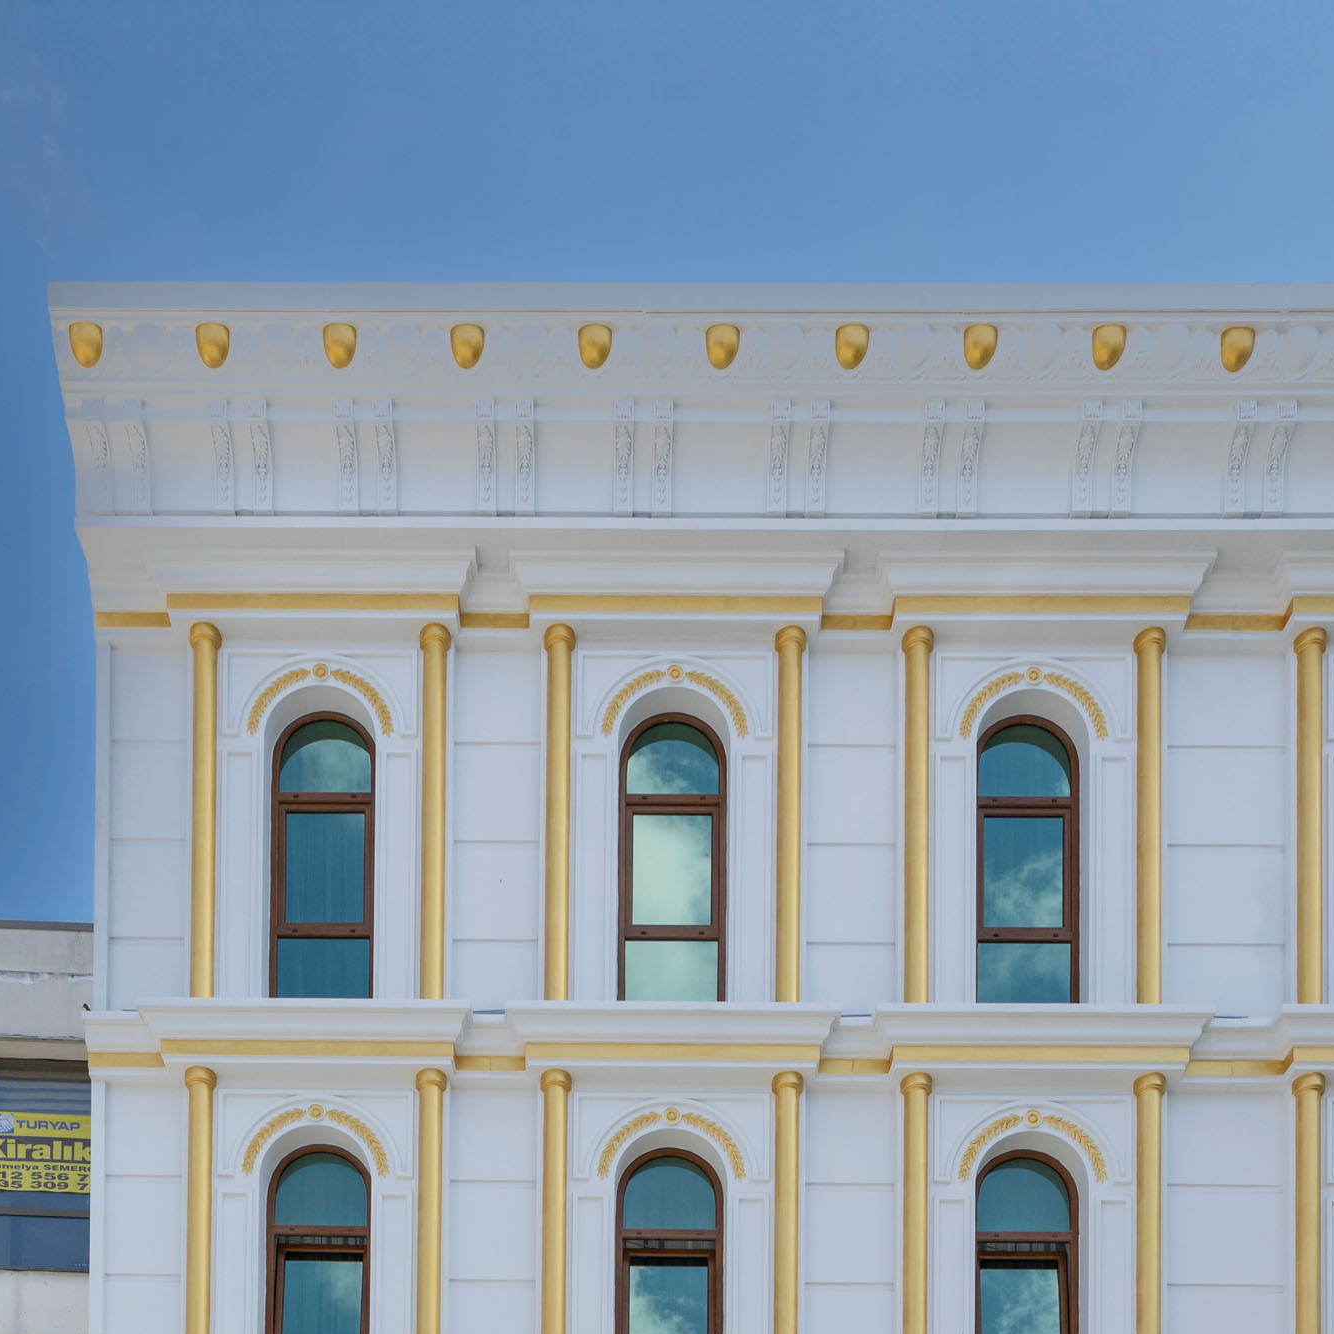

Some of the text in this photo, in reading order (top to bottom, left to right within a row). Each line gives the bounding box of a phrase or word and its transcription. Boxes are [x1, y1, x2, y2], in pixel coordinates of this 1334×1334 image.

[16, 1120, 80, 1131] TURYAP
[31, 1172, 69, 1181] 556
[77, 1173, 89, 1182] 7
[30, 1181, 69, 1190] 309
[77, 1182, 89, 1191] 7
